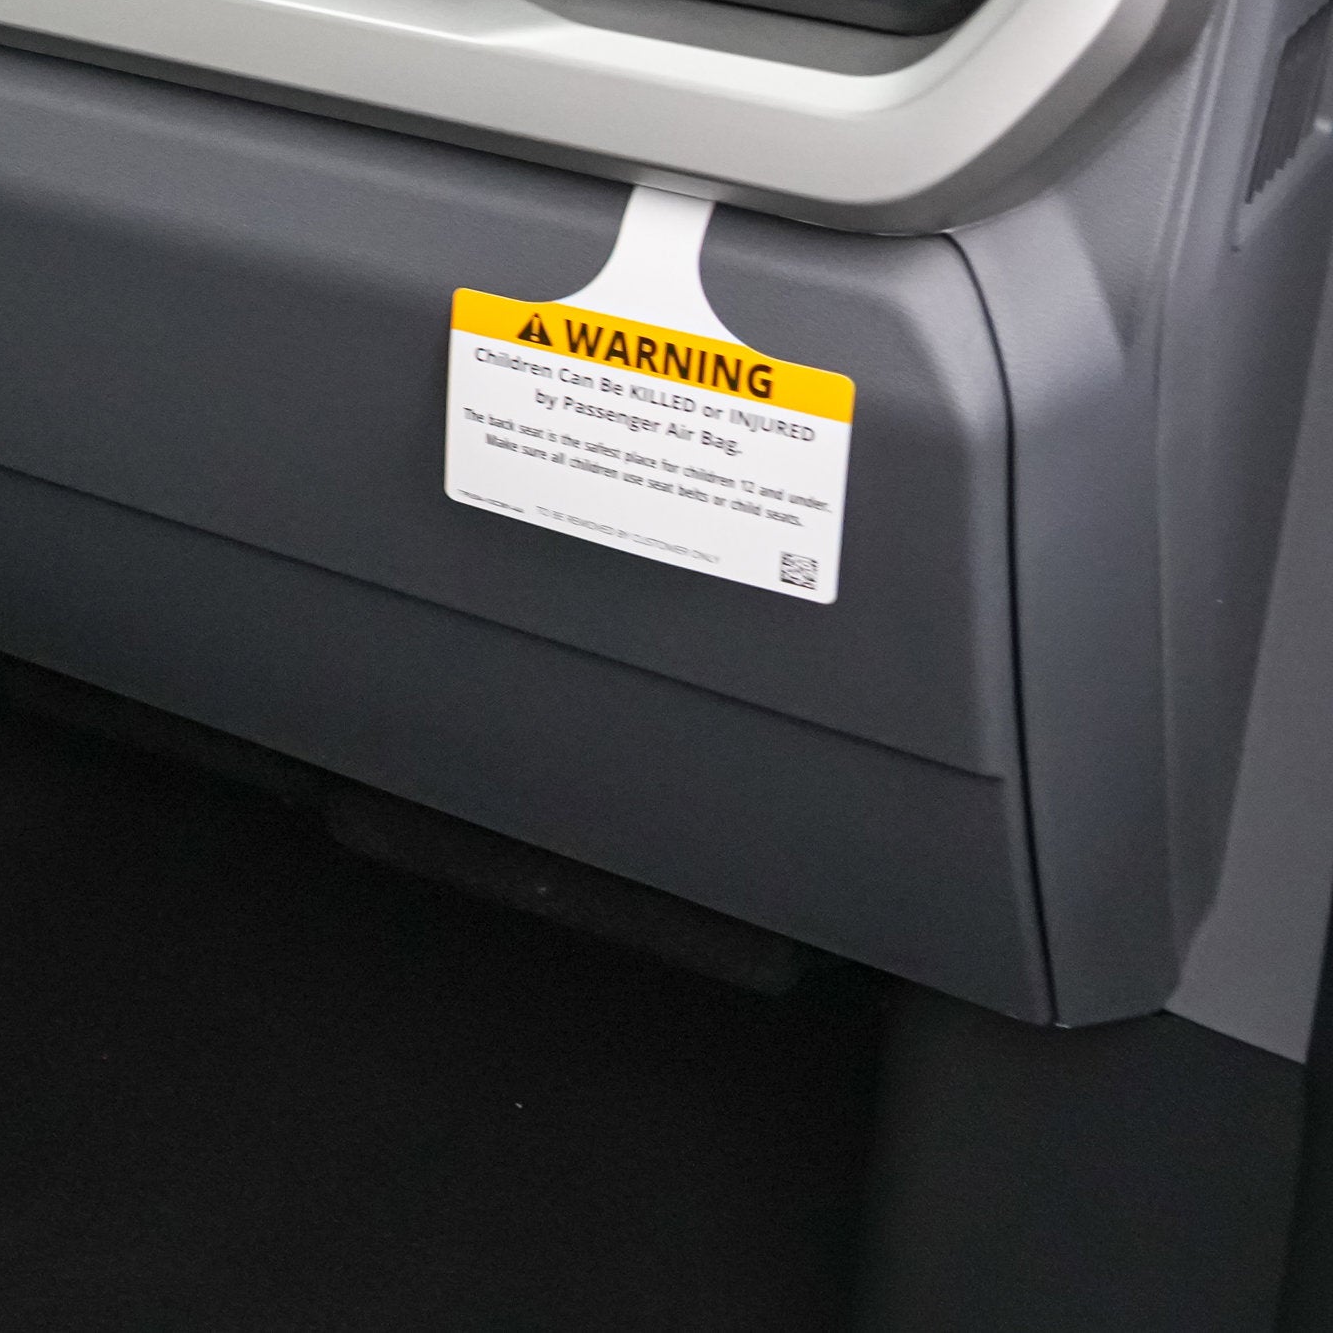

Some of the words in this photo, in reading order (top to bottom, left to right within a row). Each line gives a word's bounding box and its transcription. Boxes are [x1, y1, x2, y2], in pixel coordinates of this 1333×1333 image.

[474, 347, 553, 379] Children
[558, 367, 595, 389] Can
[600, 377, 624, 396] Be
[629, 384, 697, 414] KILLED
[702, 404, 724, 420] or
[729, 408, 816, 442] INJURED
[564, 318, 774, 400] WARNING
[463, 407, 485, 424] The
[488, 414, 515, 432] back
[518, 424, 544, 440] seat
[547, 429, 558, 443] is
[560, 434, 581, 449] the
[583, 441, 621, 459] safest
[624, 451, 658, 470] place
[660, 458, 679, 474] for
[682, 465, 736, 489] children
[740, 478, 756, 494] 12
[759, 485, 785, 502] and
[788, 494, 832, 513] under.
[535, 388, 558, 411] by
[563, 395, 662, 433] Passenger
[665, 421, 695, 441] Air
[700, 430, 743, 457] Bag.
[485, 432, 519, 453] Make
[521, 444, 548, 460] sure
[550, 451, 567, 466] all
[569, 456, 619, 480] children
[622, 471, 644, 487] use
[647, 478, 674, 494] seat
[677, 483, 709, 503] belts
[713, 495, 727, 507] or
[730, 498, 762, 517] child
